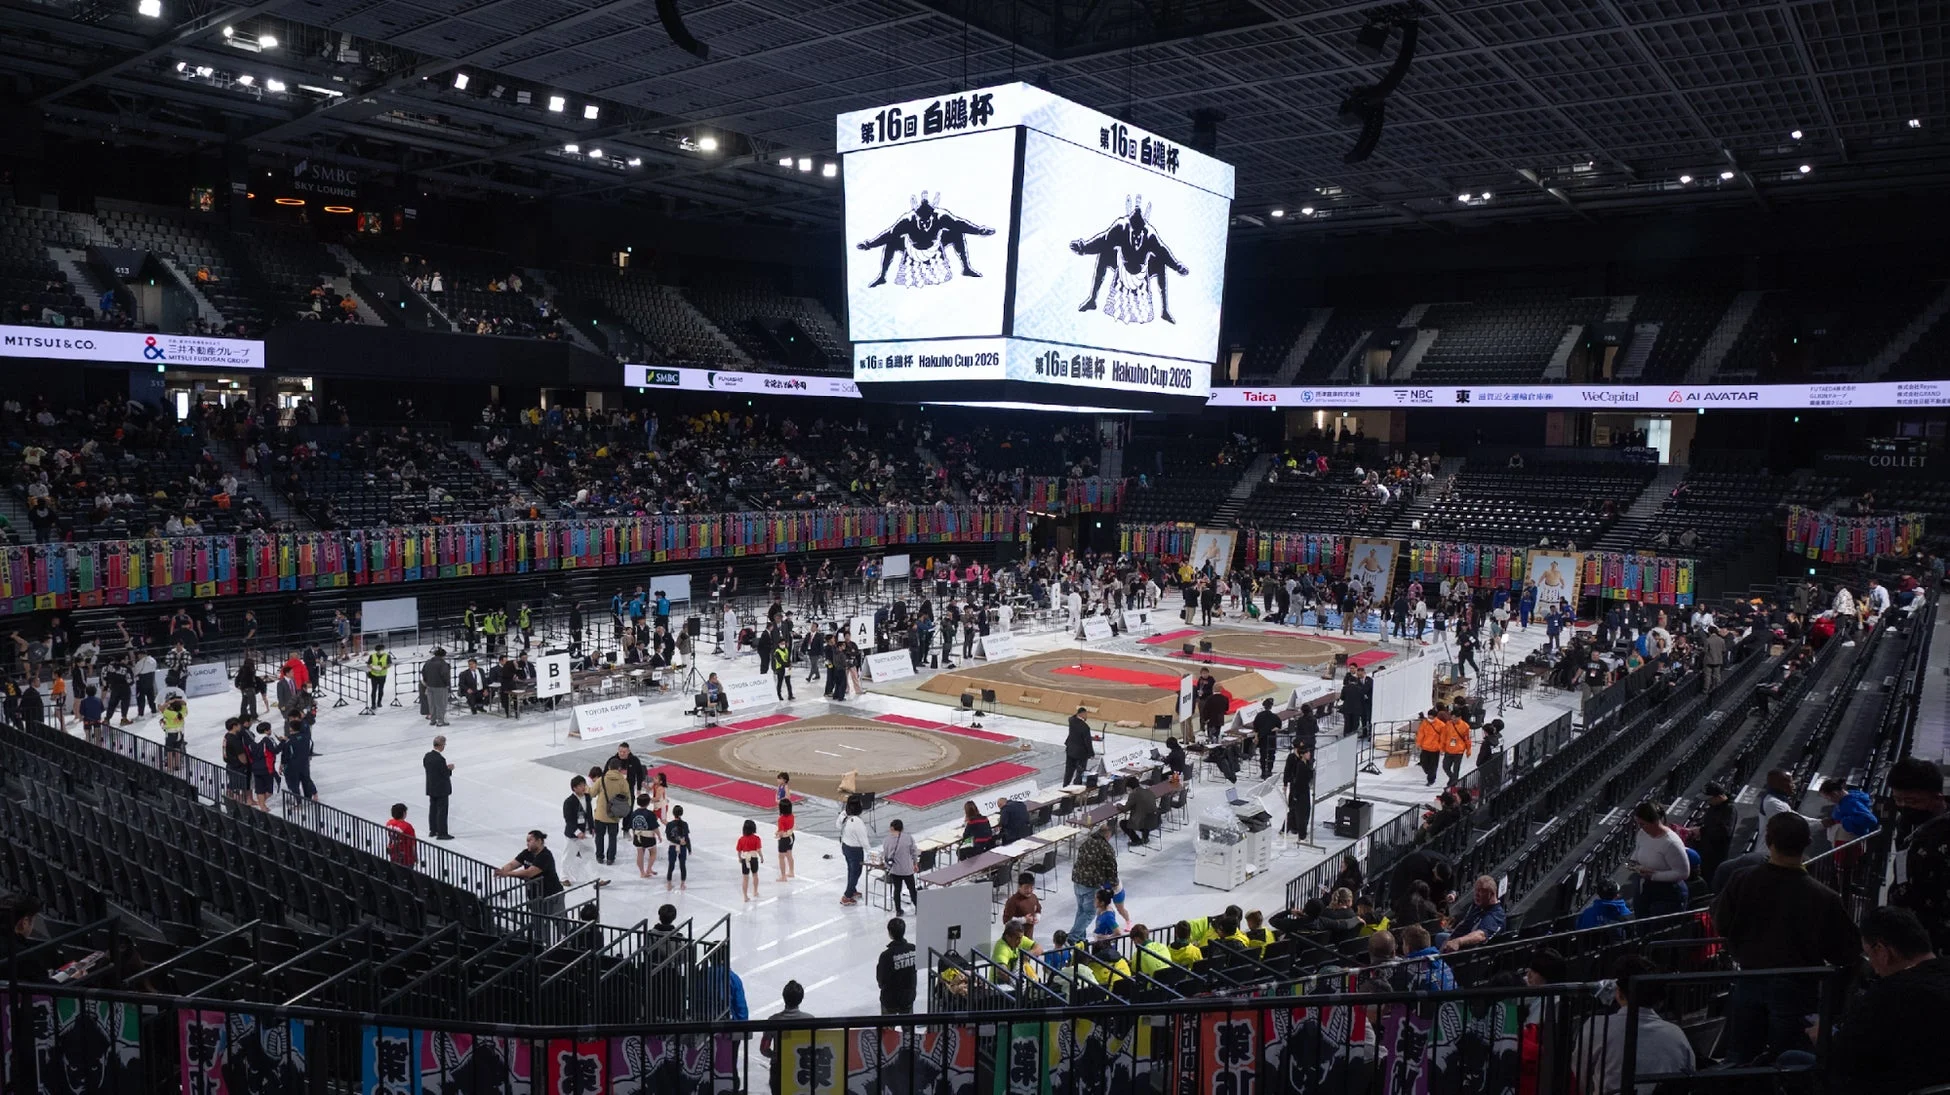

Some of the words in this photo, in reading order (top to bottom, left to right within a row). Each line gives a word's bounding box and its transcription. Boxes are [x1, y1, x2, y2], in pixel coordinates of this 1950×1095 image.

[861, 108, 918, 144] 第16回
[923, 93, 994, 136] 白鵬杯
[1099, 122, 1138, 160] 第16回
[1140, 135, 1180, 175] 白鵬杯
[312, 163, 357, 185] SMBC
[295, 180, 315, 191] SKY
[317, 184, 357, 198] LOUNGE
[4, 335, 60, 348] MITSUI
[168, 343, 250, 357] 三井不動産グループ
[919, 354, 953, 368] Hakuho
[954, 354, 974, 368] Cup
[975, 352, 999, 366] 2026
[1035, 350, 1068, 377] 第16回
[1071, 354, 1106, 380] 白鵬杯
[1112, 360, 1149, 385] Hakuho
[1149, 364, 1169, 389] Cup
[1169, 367, 1192, 389] 2026
[656, 373, 679, 383] SMBC
[1243, 391, 1276, 402] Taica
[1410, 390, 1433, 399] NBC
[1456, 390, 1471, 403] 東
[1582, 391, 1639, 403] WeCapital
[1686, 392, 1700, 401] AI
[1704, 391, 1759, 401] AVATAR
[1869, 455, 1928, 467] COLLET
[858, 622, 867, 635] A
[549, 663, 560, 677] B
[584, 705, 609, 716] TOYOTA
[610, 702, 632, 712] GROUP
[1010, 791, 1031, 803] GROUP
